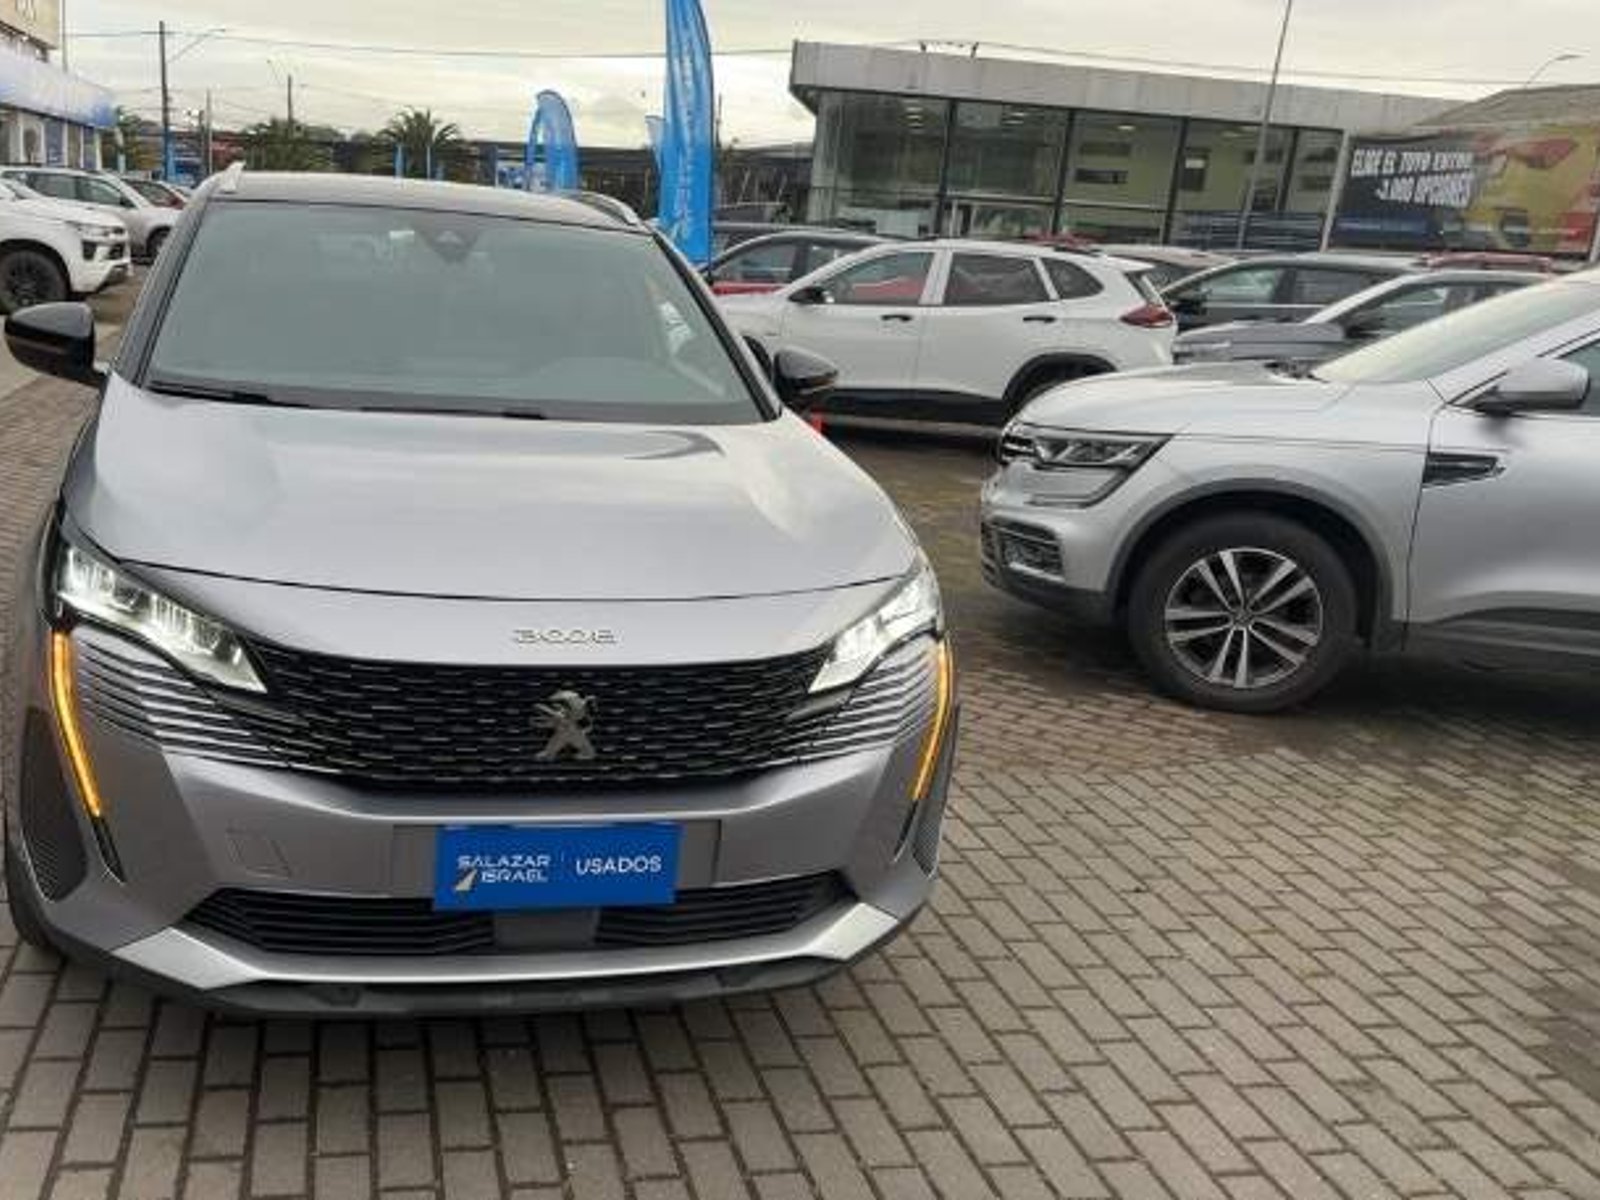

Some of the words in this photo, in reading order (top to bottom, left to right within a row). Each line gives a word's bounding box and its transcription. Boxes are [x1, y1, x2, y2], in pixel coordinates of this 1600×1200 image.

[458, 855, 551, 869] SALAZAR
[576, 856, 662, 875] USADOS
[481, 869, 548, 883] ISRAEL
